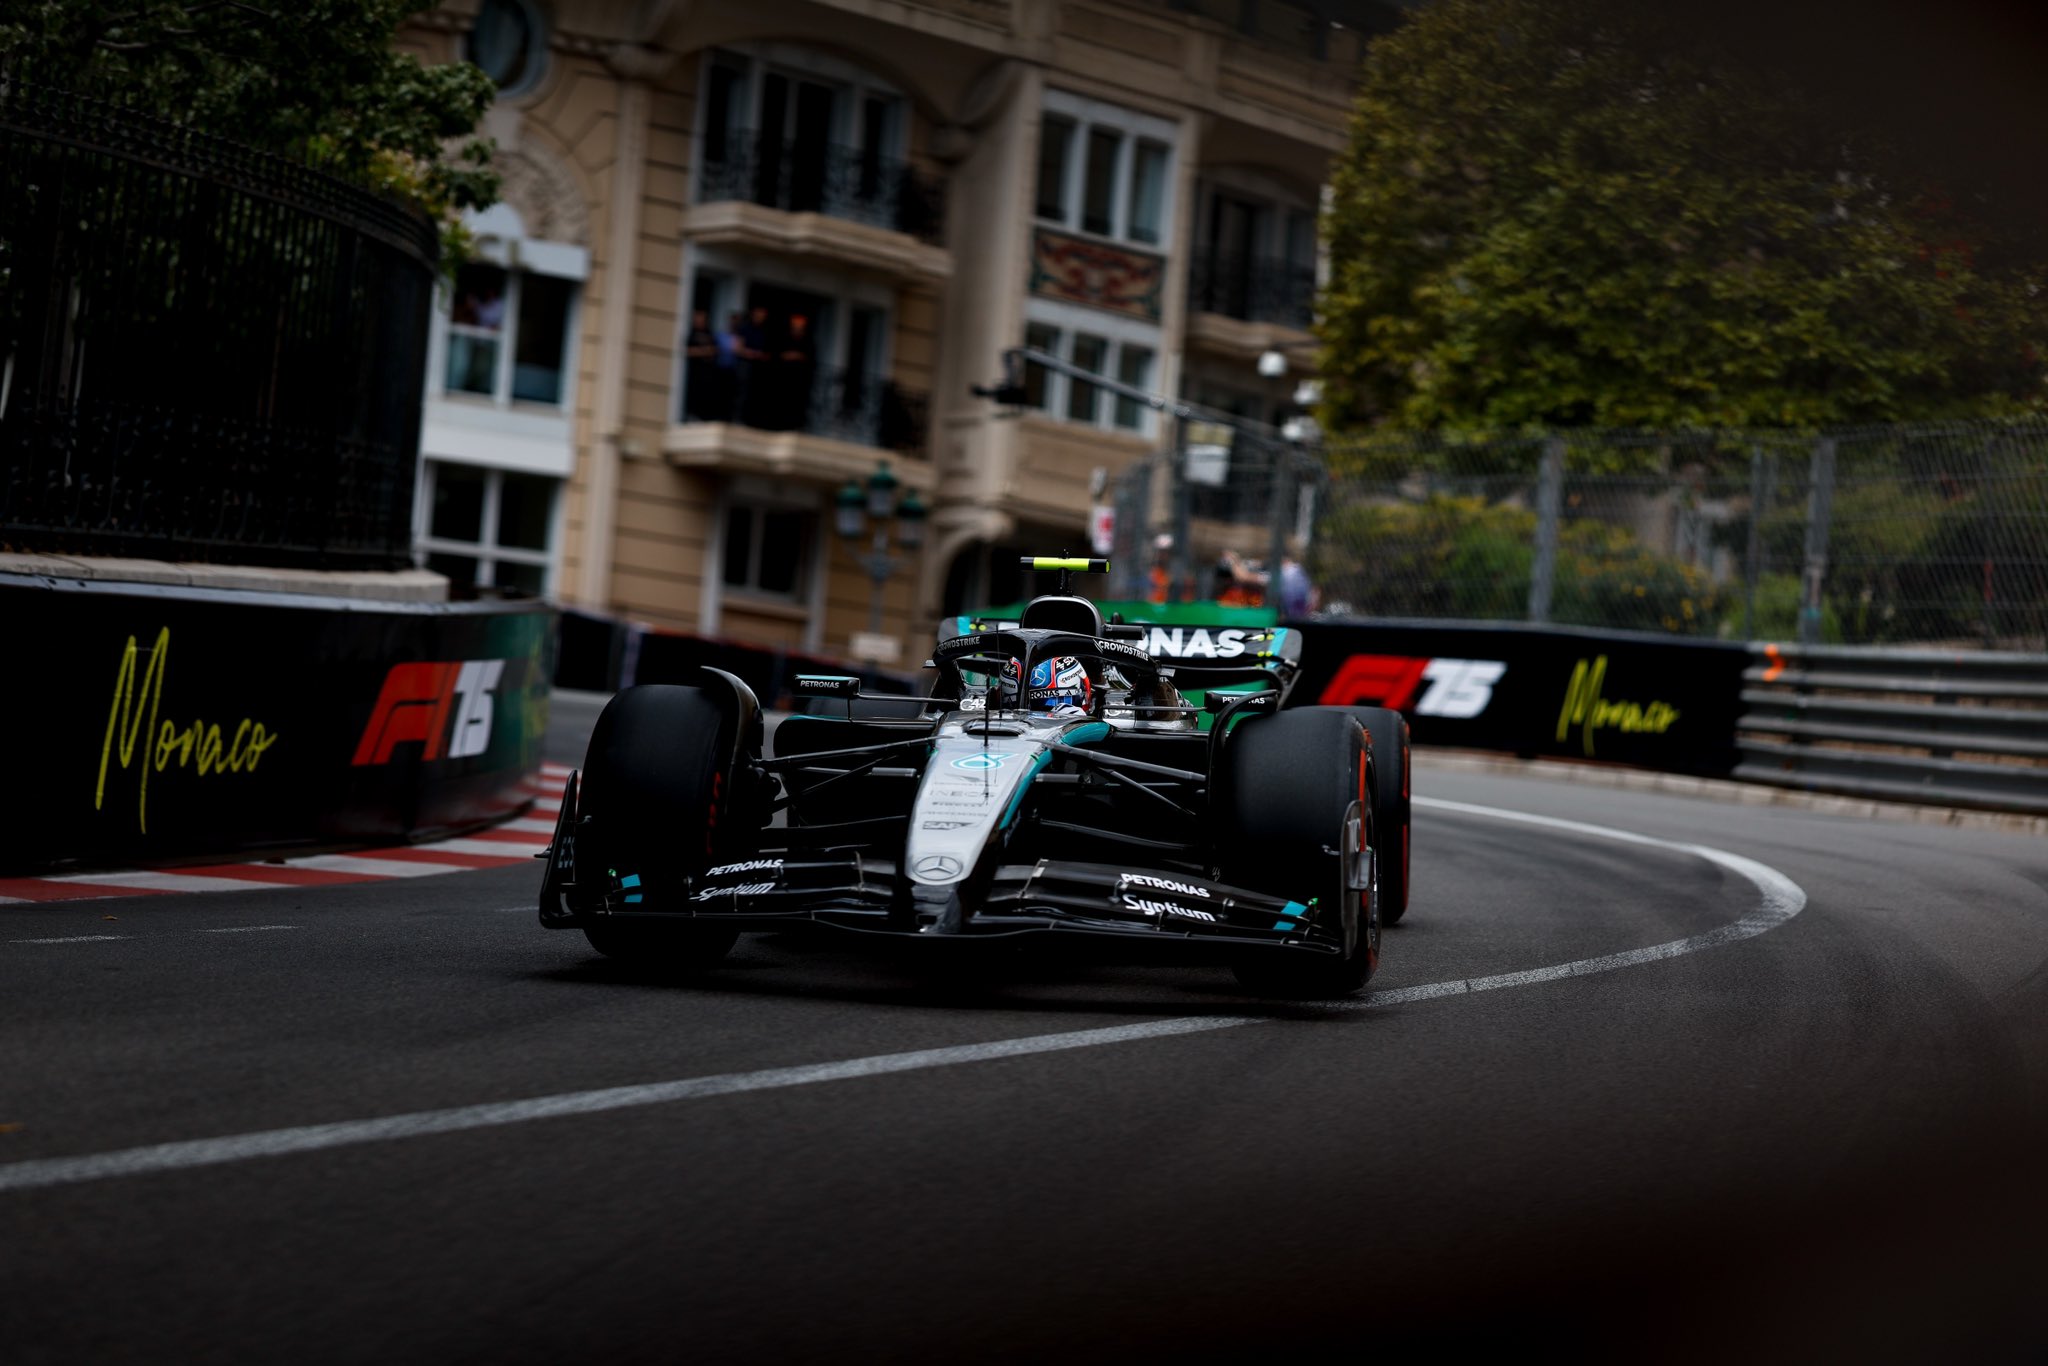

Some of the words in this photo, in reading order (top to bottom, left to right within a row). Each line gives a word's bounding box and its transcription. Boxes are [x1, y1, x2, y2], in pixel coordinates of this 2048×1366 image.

[1099, 640, 1149, 661] CROWDSTRIKE
[800, 680, 840, 689] PETRONAS
[960, 699, 987, 711] G42
[96, 626, 277, 834] Monaco
[705, 858, 784, 877] PETRONAS
[1120, 873, 1211, 898] PETRONAS
[1121, 894, 1216, 922] Syntium
